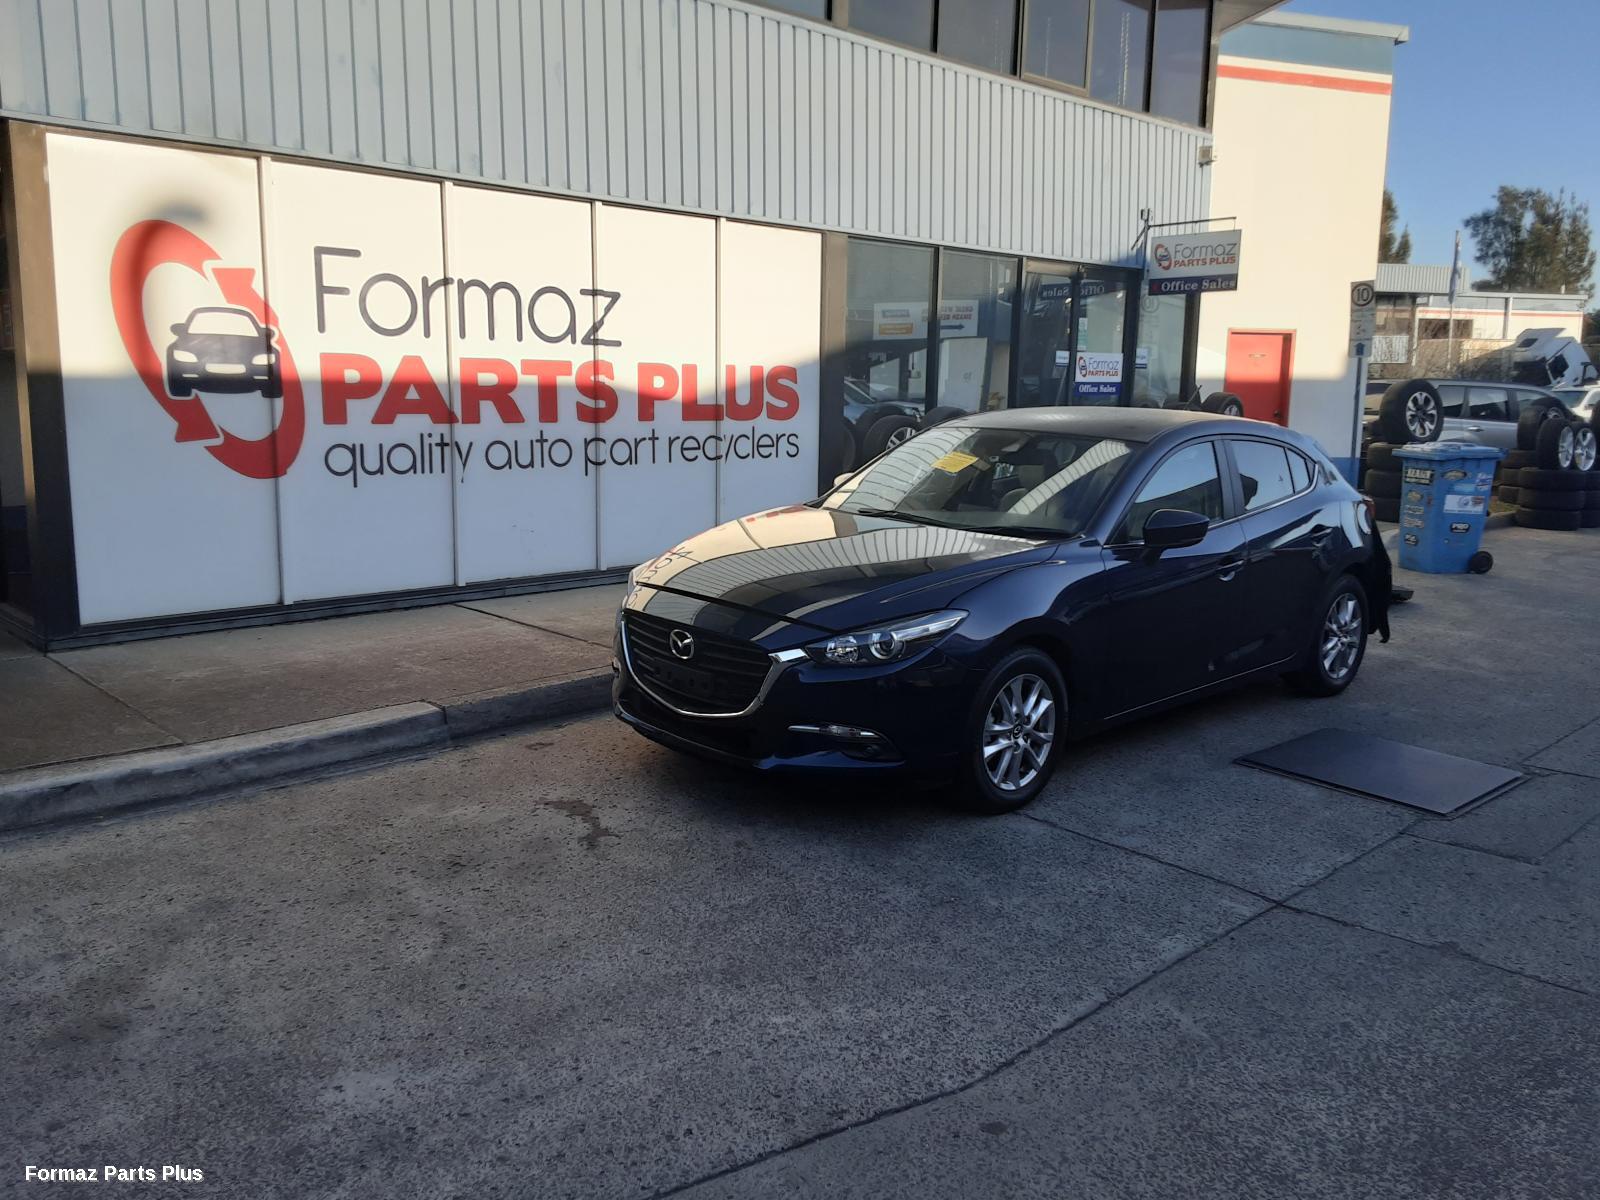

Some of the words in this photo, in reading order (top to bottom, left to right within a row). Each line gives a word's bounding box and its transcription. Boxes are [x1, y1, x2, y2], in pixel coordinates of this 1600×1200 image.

[1174, 242, 1238, 259] Formaz
[1173, 258, 1207, 268] PARTS
[1209, 256, 1236, 266] PLUS
[1161, 280, 1199, 292] Office
[1201, 278, 1236, 290] Sales
[313, 246, 622, 347] Formaz
[1356, 287, 1370, 302] 10
[1088, 357, 1120, 371] Formaz
[319, 352, 619, 425] PARTS
[637, 362, 800, 422] PLUS
[1079, 384, 1099, 393] Office
[1099, 384, 1116, 393] Sales
[324, 432, 473, 488] quality
[485, 429, 573, 471] auto
[584, 427, 660, 476] part
[668, 425, 800, 465] recyclers
